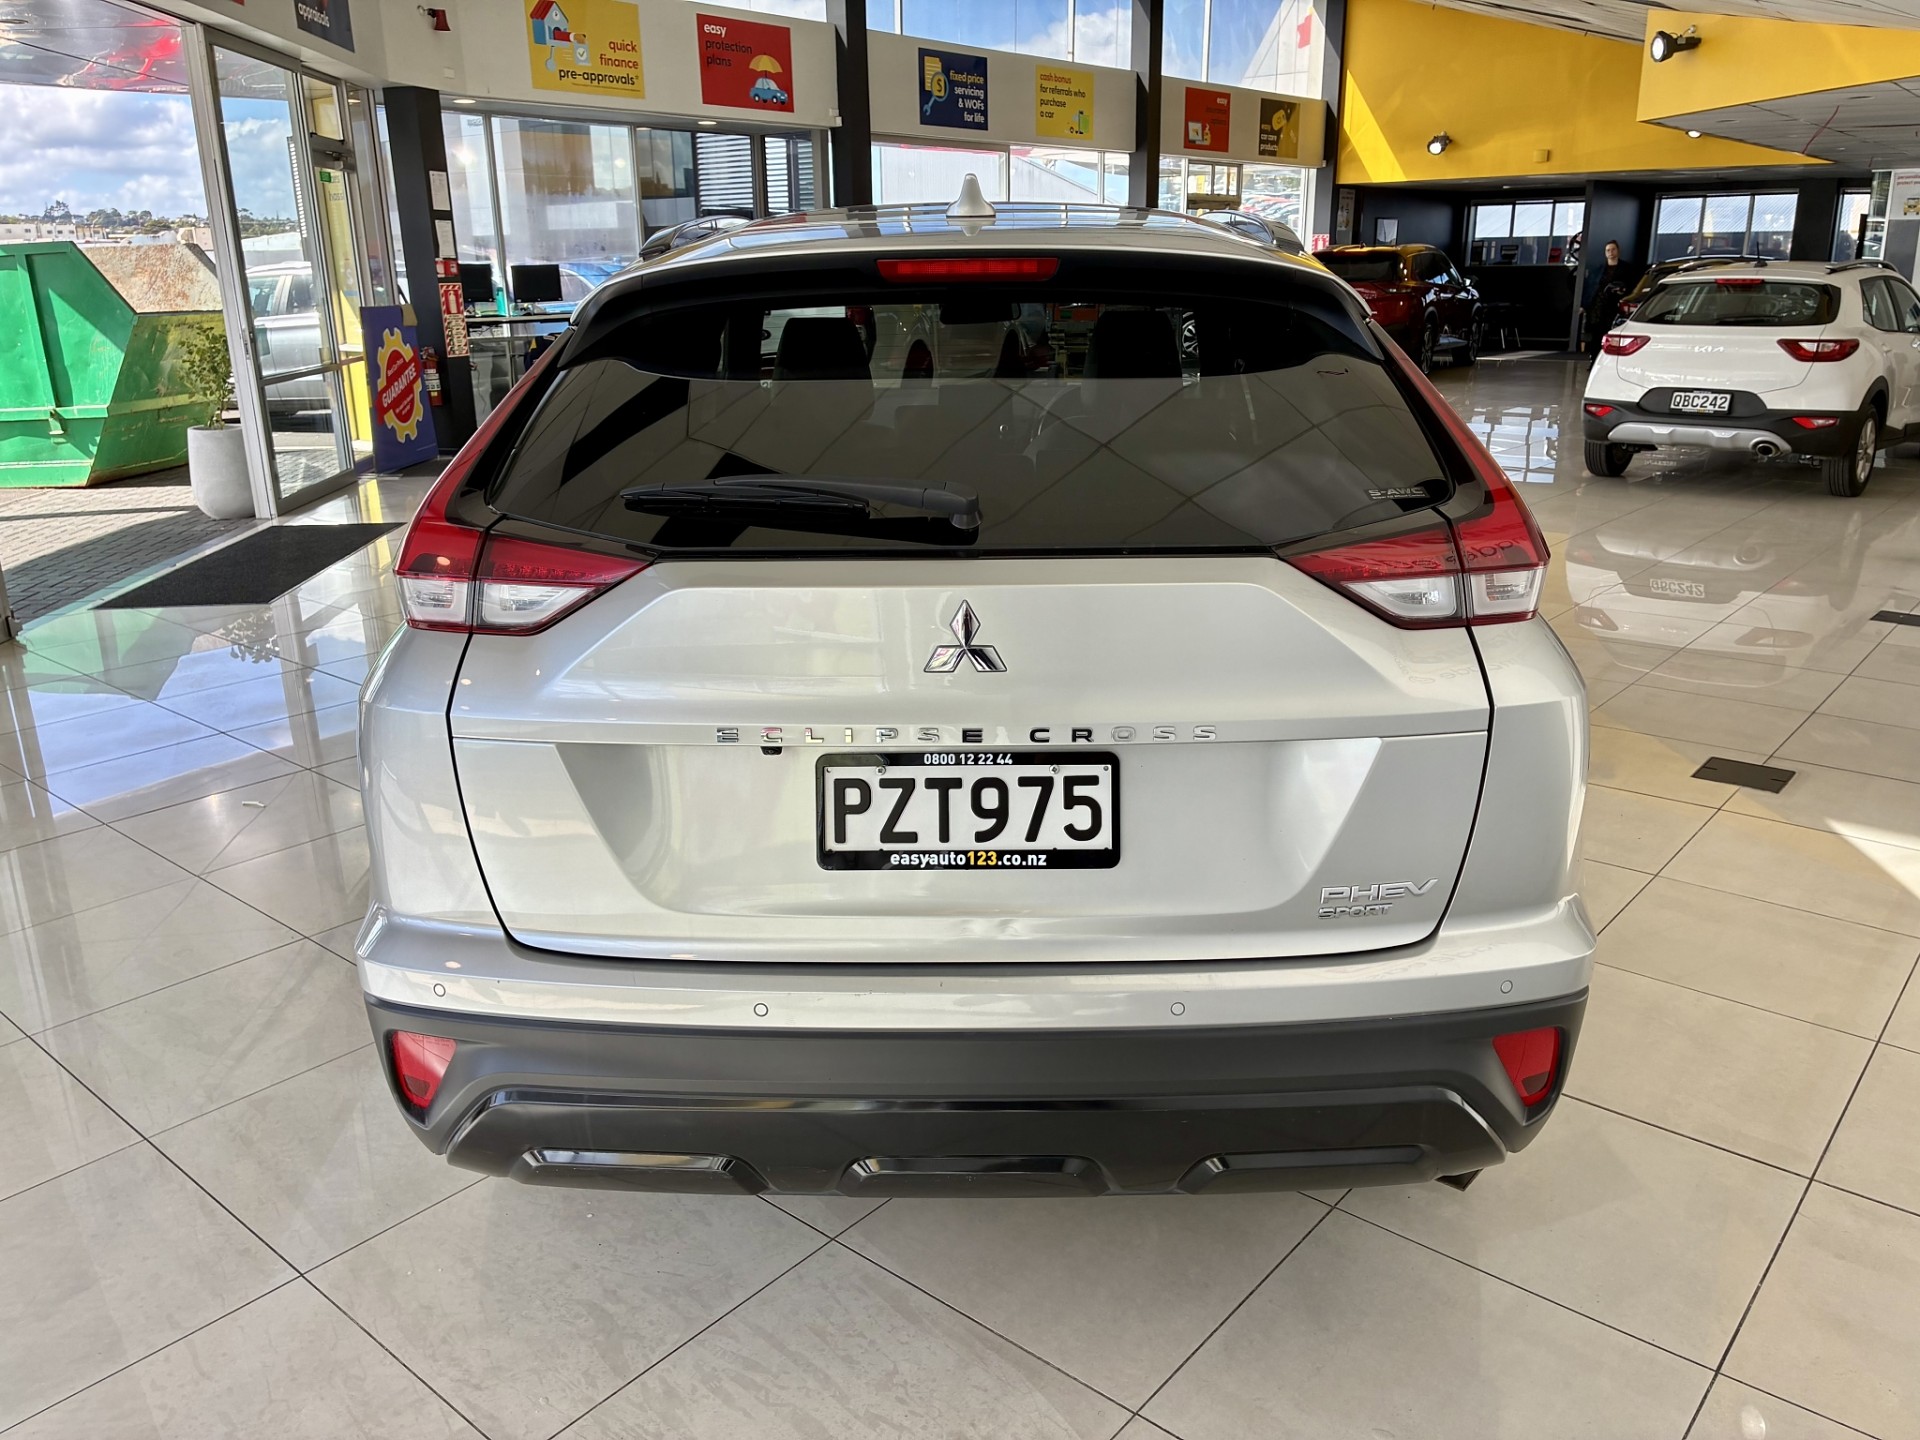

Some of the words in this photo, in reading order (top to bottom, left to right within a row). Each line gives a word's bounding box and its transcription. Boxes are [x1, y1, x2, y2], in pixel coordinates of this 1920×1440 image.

[298, 2, 330, 28] appraisals
[703, 23, 727, 38] easy
[608, 39, 638, 53] quick
[705, 39, 752, 54] protection
[599, 53, 639, 69] finance
[707, 54, 732, 67] plans
[949, 70, 967, 82] fixed
[967, 73, 985, 85] price
[1040, 72, 1053, 82] cash
[1054, 74, 1072, 85] bonus
[954, 85, 985, 99] servicing
[1040, 83, 1048, 94] for
[1049, 85, 1073, 97] referrals
[1073, 89, 1086, 98] who
[958, 98, 964, 108] &
[964, 98, 985, 111] WOFs
[1040, 98, 1067, 108] purchase
[964, 111, 974, 122] for
[974, 112, 985, 123] life
[1045, 111, 1054, 119] car
[382, 362, 417, 408] GUARANTEE
[1672, 394, 1729, 410] QBC242
[1368, 487, 1424, 497] S-AWC
[716, 727, 985, 743] ECLIPSE
[1029, 725, 1217, 743] CROSS
[924, 754, 957, 765] 0800
[959, 754, 976, 766] 12
[978, 754, 995, 766] 22
[996, 754, 1013, 765] 44
[833, 775, 1103, 844] PZT975
[890, 851, 1047, 869] easyauto123.co.nz
[1320, 878, 1438, 904] PHEV
[1318, 903, 1393, 920] SPORT
